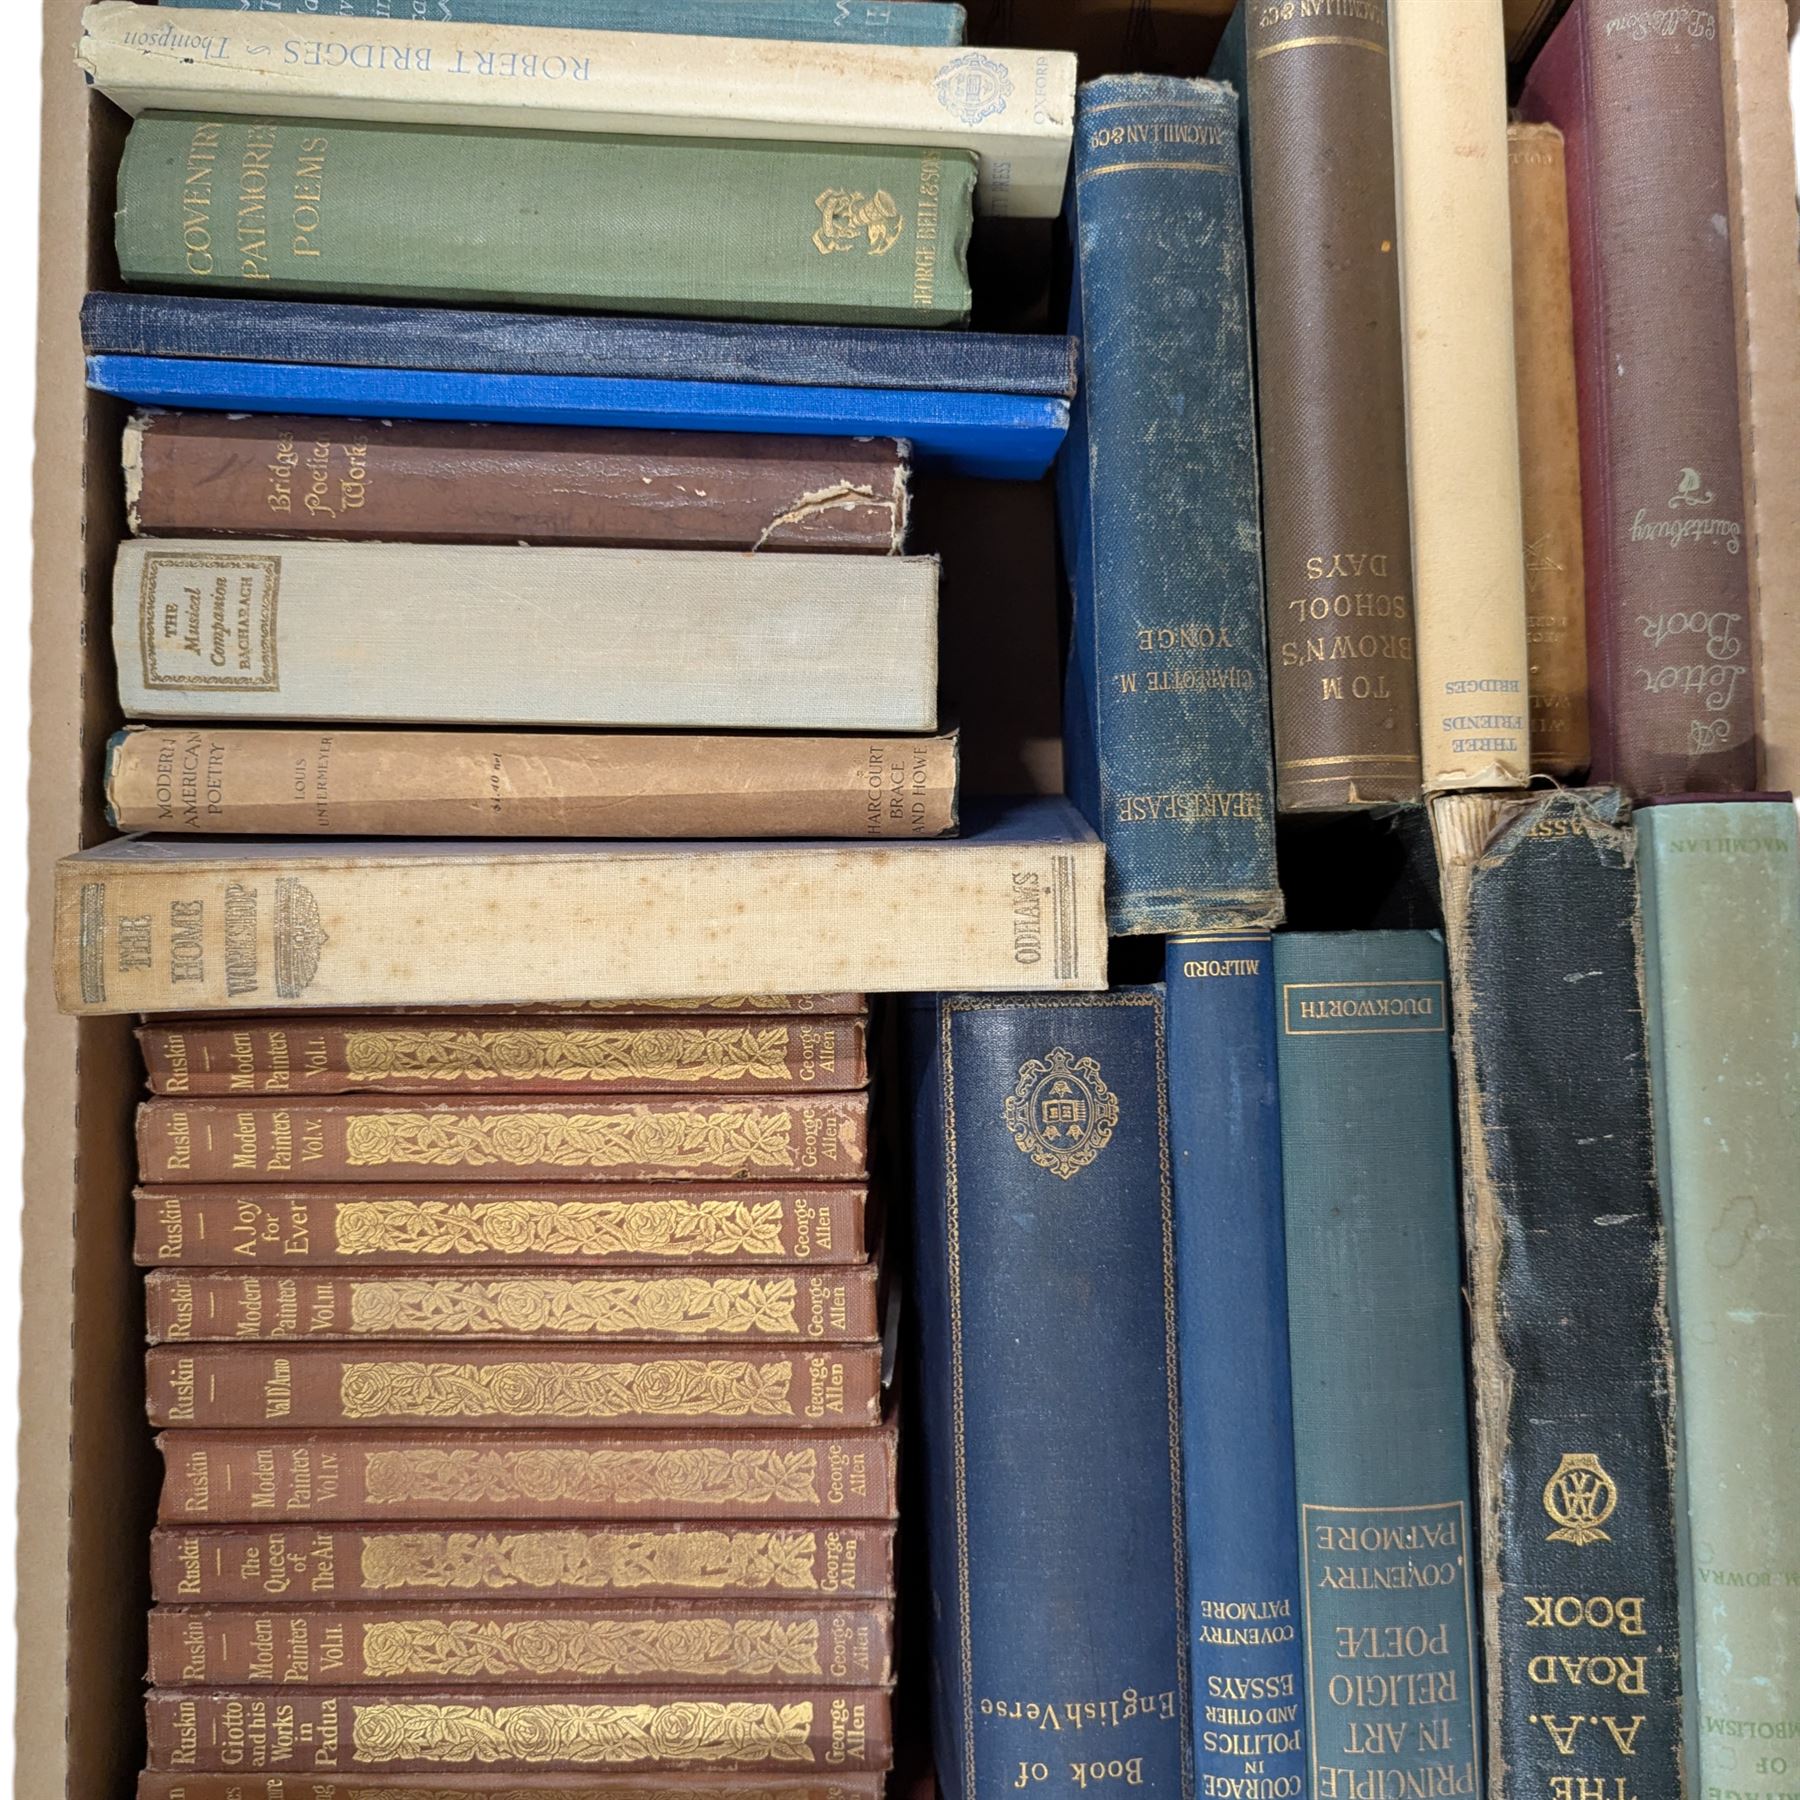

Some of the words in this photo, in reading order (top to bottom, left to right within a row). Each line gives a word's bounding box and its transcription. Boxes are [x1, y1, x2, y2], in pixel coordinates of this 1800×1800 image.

[123, 27, 231, 59] Thompson
[1605, 12, 1648, 41] Sons
[1661, 9, 1708, 38] Bell
[284, 39, 433, 71] BRIDGES
[447, 50, 592, 81] ROBERT
[1033, 56, 1049, 125] OXFORD
[1109, 127, 1128, 145] &
[1128, 122, 1224, 147] MACMILLAN
[183, 119, 225, 277] COVENTRY
[292, 136, 329, 258] POEMS
[991, 161, 1012, 193] PRESS
[915, 197, 940, 241] BELL
[911, 243, 937, 309] GEORGE
[267, 430, 299, 514] Bridges
[340, 434, 373, 513] Works
[1631, 507, 1741, 555] Saintsbury
[1306, 554, 1389, 581] DAYS
[165, 602, 179, 639] THE
[184, 587, 203, 657] Musical
[210, 576, 232, 668] Companion
[238, 576, 255, 671] BACHARACH
[1288, 594, 1406, 623] SCHOOL
[1137, 627, 1234, 652] YONGE
[1281, 635, 1413, 667] BROWN'S
[1635, 610, 1742, 660] Book
[1148, 668, 1254, 694] CHARLOTTE
[1444, 679, 1520, 696] BRIDGES
[1635, 664, 1746, 712] Letter
[1442, 714, 1524, 732] FRIENDS
[491, 752, 503, 770] net
[1452, 738, 1519, 754] THREE
[155, 736, 179, 820] MODERN
[179, 732, 203, 829] AMERICAN
[207, 742, 227, 816] POETRY
[295, 757, 308, 801] LOUIS
[316, 735, 334, 828] UNTERMEYER
[866, 746, 885, 835] HARCOURT
[889, 760, 906, 820] BRACE
[912, 746, 928, 798] HOWE
[911, 801, 926, 835] AND
[1118, 791, 1264, 823] HEARTSEASE
[1669, 836, 1790, 854] MACMILLAN
[1010, 870, 1043, 966] ODHAMS
[117, 914, 153, 973] THE
[170, 899, 205, 985] HOME
[224, 883, 260, 999] WORKSHOP
[1183, 959, 1261, 979] MILFORD
[1300, 997, 1433, 1019] DUCKWORTH
[163, 1034, 190, 1093] Ruskin
[230, 1031, 255, 1091] Modern
[265, 1030, 290, 1091] Painters
[799, 1023, 821, 1082] George
[819, 1030, 835, 1073] Allen
[167, 1111, 191, 1170] Ruskin
[232, 1111, 257, 1169] Modern
[266, 1109, 292, 1172] Painters
[802, 1108, 823, 1168] George
[821, 1116, 838, 1161] Allen
[158, 1194, 183, 1259] Ruskin
[232, 1199, 263, 1236] Joy
[260, 1212, 281, 1242] for
[284, 1200, 310, 1255] Ever
[794, 1197, 816, 1258] George
[815, 1206, 832, 1250] Allen
[232, 1239, 257, 1257] A
[236, 1277, 263, 1338] Modern
[271, 1278, 298, 1338] Painters
[808, 1276, 831, 1337] George
[830, 1286, 846, 1331] Allen
[168, 1358, 195, 1421] Ruskin
[264, 1358, 292, 1399] D'Arno
[804, 1356, 829, 1418] George
[825, 1363, 844, 1414] Allen
[265, 1399, 292, 1420] Val
[184, 1450, 209, 1512] Ruskin
[250, 1448, 276, 1509] Modern
[286, 1447, 312, 1511] Painters
[827, 1444, 851, 1504] George
[850, 1453, 867, 1497] Allen
[309, 1531, 334, 1560] Air
[1314, 1520, 1459, 1551] PATMORE
[240, 1547, 261, 1581] The
[263, 1532, 292, 1594] Queen
[286, 1552, 308, 1573] of
[311, 1562, 335, 1592] The
[820, 1530, 844, 1593] George
[841, 1539, 858, 1590] Allen
[1319, 1562, 1458, 1590] COVENTRY
[1698, 1567, 1772, 1586] BOWRA
[1200, 1599, 1290, 1620] PATMORE
[1524, 1596, 1647, 1636] BOOK
[182, 1619, 206, 1681] Ruskin
[248, 1617, 274, 1680] Modern
[283, 1617, 309, 1683] Painters
[830, 1617, 853, 1678] George
[852, 1626, 869, 1672] Allen
[1199, 1625, 1295, 1645] COVENTRY
[1207, 1674, 1295, 1700] ESSAYS
[1328, 1669, 1459, 1707] RELIGIO
[1527, 1654, 1651, 1695] ROAD
[246, 1700, 267, 1729] his
[980, 1698, 1062, 1731] Verse
[1065, 1687, 1176, 1730] English
[1205, 1705, 1263, 1725] OTHER
[1265, 1703, 1298, 1723] AND
[170, 1701, 198, 1765] Ruskin
[221, 1701, 245, 1765] Giotto
[248, 1730, 267, 1768] and
[270, 1704, 294, 1763] Works
[294, 1722, 313, 1742] in
[314, 1697, 338, 1767] Padua
[825, 1698, 850, 1765] George
[847, 1703, 866, 1761] Allen
[1202, 1729, 1302, 1755] POLITICS
[1343, 1722, 1411, 1755] ART
[1417, 1719, 1451, 1752] IN
[1014, 1761, 1049, 1789] of
[1071, 1757, 1144, 1789] Book
[1203, 1774, 1301, 1800] COURAGE
[1244, 1760, 1265, 1774] IN
[1319, 1761, 1477, 1800] PRINCIPLE
[1548, 1775, 1638, 1800] THE
[1755, 1756, 1788, 1775] OF
